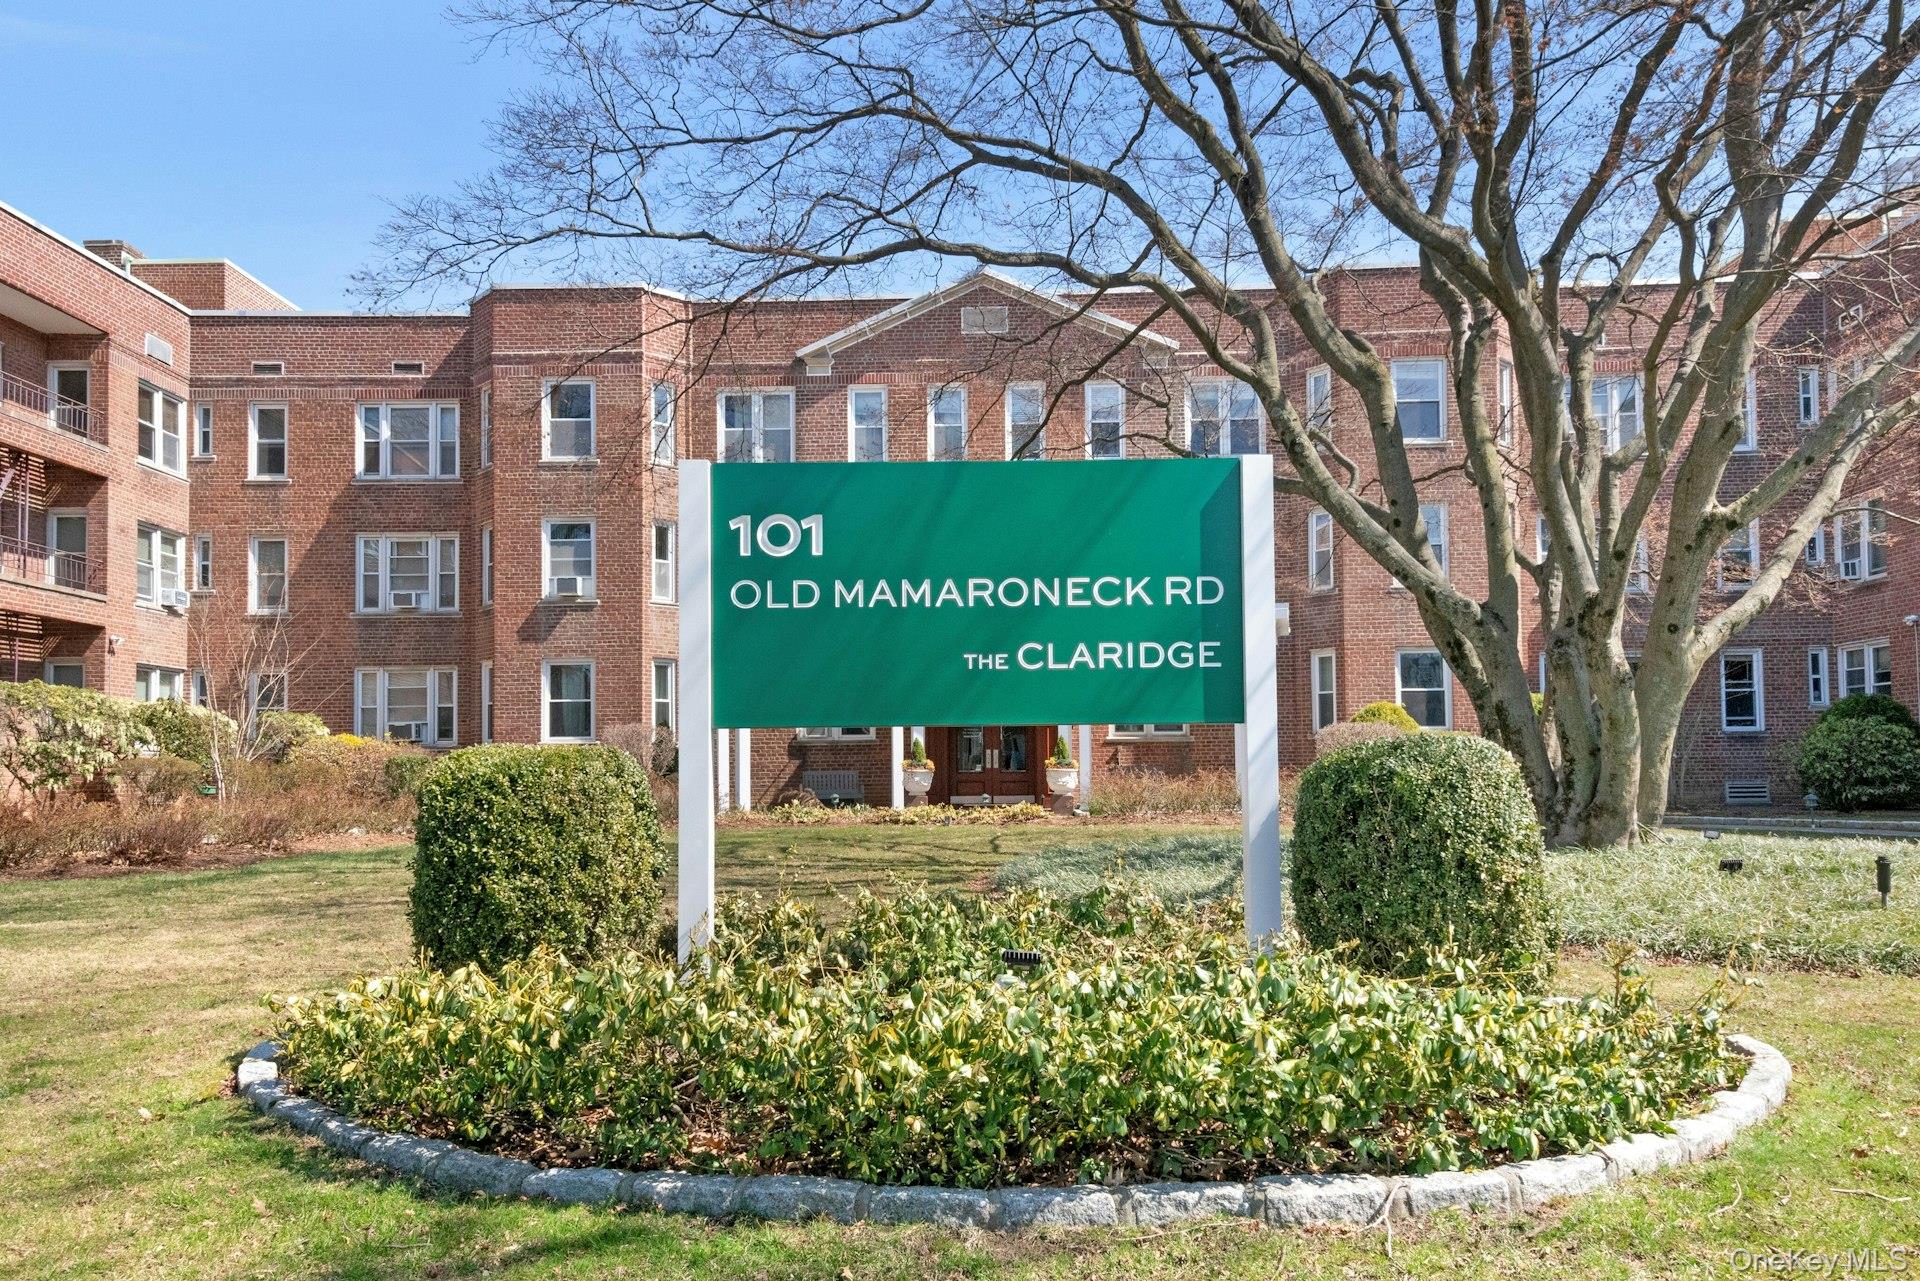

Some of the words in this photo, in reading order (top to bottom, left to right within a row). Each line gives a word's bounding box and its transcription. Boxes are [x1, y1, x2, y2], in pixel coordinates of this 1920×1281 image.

[728, 513, 824, 558] 101
[730, 579, 821, 610] OLD
[834, 576, 1155, 609] MAMARONECK
[1164, 576, 1225, 606] RD
[963, 653, 1010, 671] THE
[1017, 641, 1223, 671] CLARIDGE
